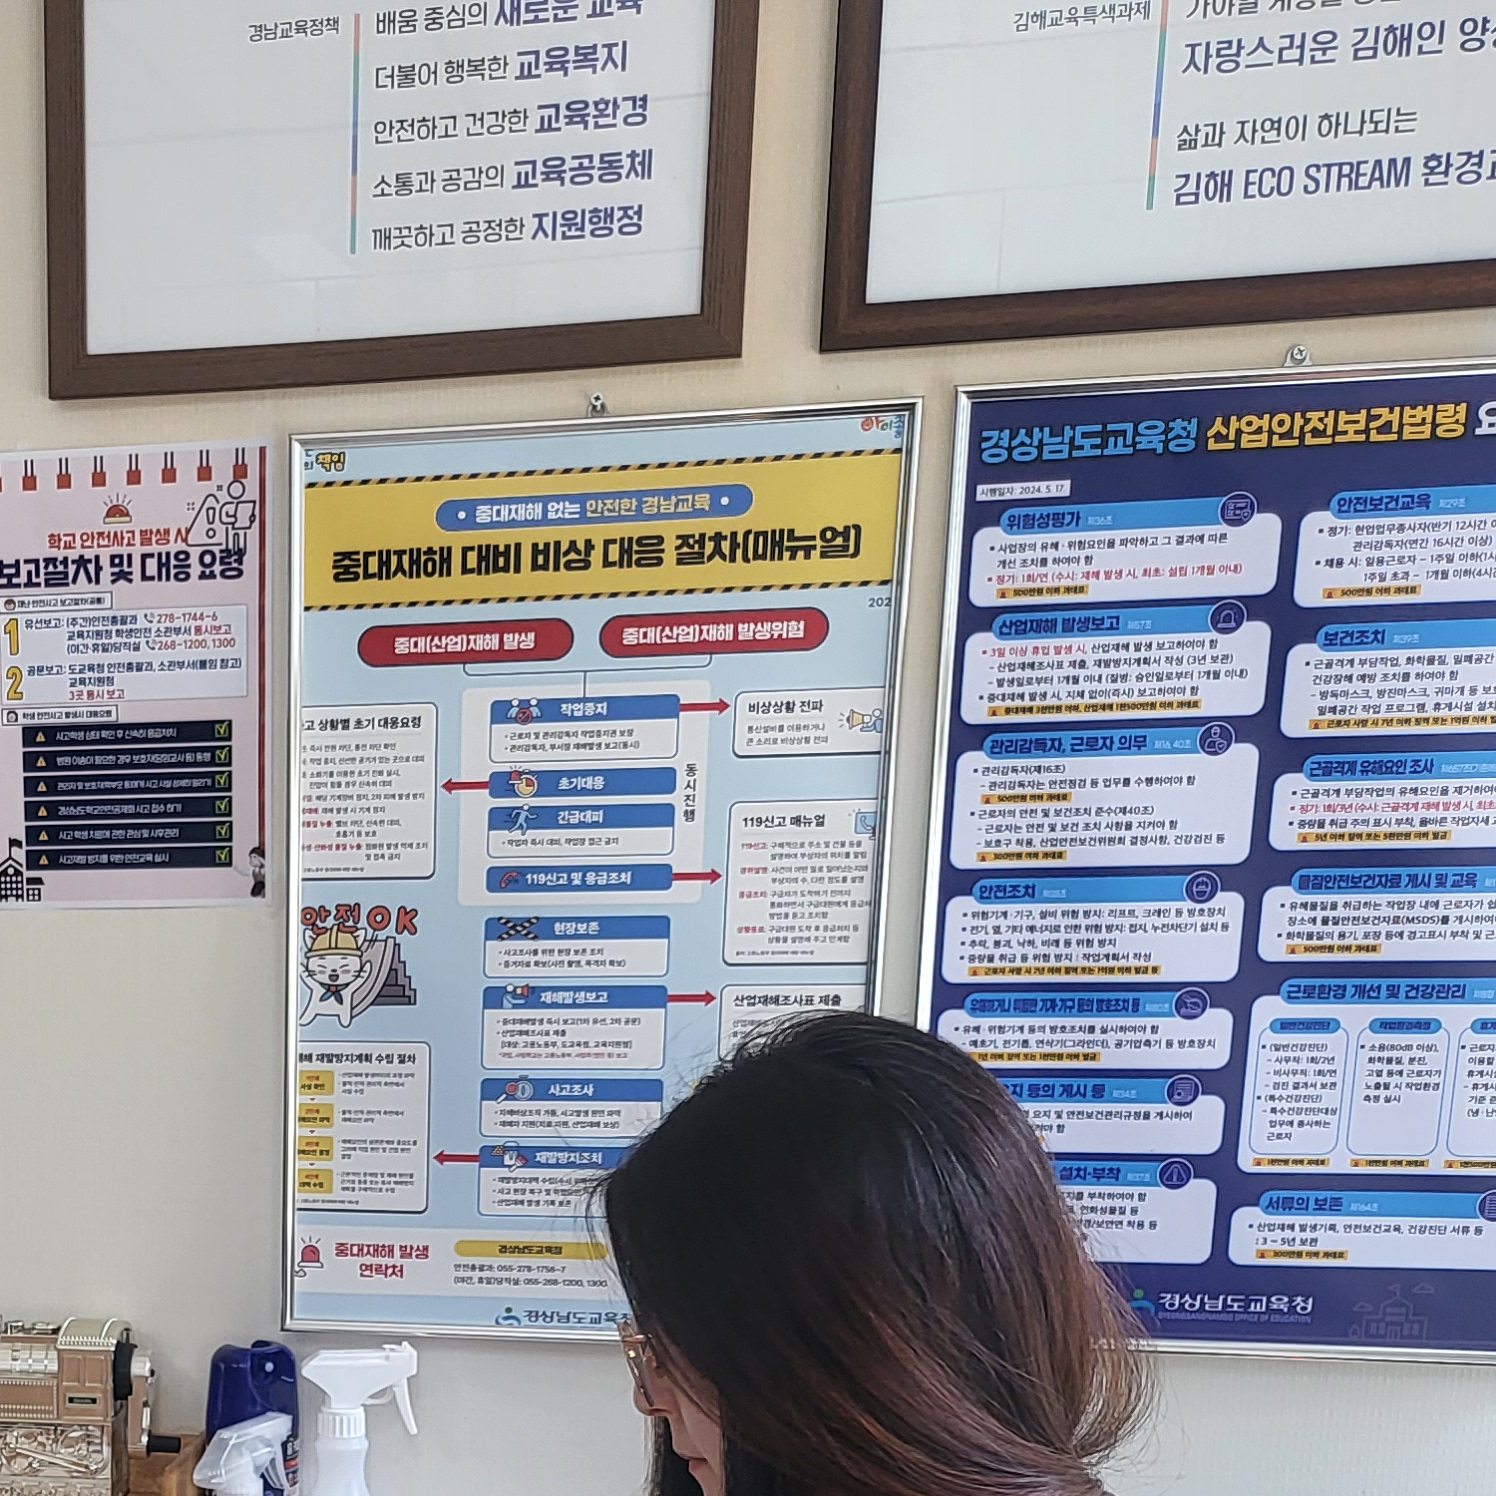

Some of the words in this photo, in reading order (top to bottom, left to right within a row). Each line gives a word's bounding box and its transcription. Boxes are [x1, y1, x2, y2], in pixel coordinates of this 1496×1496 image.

[377, 9, 418, 34] 배움
[424, 2, 487, 31] 중심의
[1014, 0, 1150, 32] 김해교육특색과제
[249, 17, 339, 42] 경남교육정책
[1182, 31, 1338, 74] 자랑스러운
[1352, 20, 1445, 61] 김해인
[376, 62, 437, 89] 더불어
[445, 55, 509, 84] 행복한
[515, 41, 627, 80] 교육복지
[374, 116, 458, 144] 안전하고
[465, 108, 529, 136] 건강한
[535, 94, 647, 133] 교육환경
[1177, 122, 1226, 151] 삶과
[1234, 115, 1307, 145] 자연이
[1318, 107, 1417, 139] 하나되는
[373, 171, 436, 197] 소통과
[441, 165, 504, 192] 공감의
[512, 149, 652, 189] 교육공동체
[1174, 170, 1233, 205] 김해
[1244, 166, 1294, 199] ECO
[1304, 157, 1411, 194] STREAM
[372, 224, 455, 250] 깨끗하고
[461, 217, 525, 244] 공정한
[532, 204, 642, 241] 지원행정
[978, 417, 1198, 464] 경상남도교육청
[1206, 402, 1468, 452] 산업안전보건법령
[475, 502, 542, 524] 중대재해
[547, 502, 580, 522] 없는
[586, 496, 638, 519] 안전한
[642, 493, 710, 515] 경남교육
[1337, 494, 1431, 514] 안전보건교육
[1006, 510, 1081, 531] 위험성평가
[48, 533, 76, 551] 학교
[80, 530, 135, 549] 안전사고
[140, 528, 172, 548] 발생
[332, 546, 452, 584] 중대재해
[461, 544, 521, 576] 대비
[530, 539, 595, 573] 비상
[604, 535, 665, 570] 대응
[674, 524, 862, 565] 절차(매뉴얼)
[110, 554, 133, 584] 및
[141, 551, 191, 582] 대응
[198, 547, 246, 580] 요령
[622, 622, 734, 646] 중대(산업)재해
[738, 620, 805, 641] 발생위험
[999, 618, 1058, 635] 산업재해
[1062, 616, 1120, 631] 발생보고
[393, 631, 499, 655] 중대(산업)재해
[504, 629, 535, 652] 발생
[1323, 629, 1386, 646] 보건조치
[560, 702, 607, 717] 작업중지
[749, 700, 796, 714] 비상상황
[800, 700, 823, 712] 전파
[1070, 736, 1113, 752] 근로자
[1117, 735, 1147, 750] 의무
[558, 776, 605, 790] 초기대응
[557, 810, 604, 824] 긴급대피
[743, 816, 786, 828] 119신고
[790, 814, 825, 827] 매뉴얼
[526, 873, 568, 885] 119신고
[571, 872, 582, 885] 및
[585, 871, 632, 885] 응급조치
[979, 884, 1035, 899] 안전조치
[366, 906, 418, 935] OK
[733, 996, 814, 1008] 산업재해조사표
[818, 995, 841, 1006] 제출
[1286, 984, 1347, 999] 근로환경
[1351, 984, 1381, 999] 개선
[1386, 984, 1400, 999] 및
[1405, 984, 1466, 999] 건강관리
[1265, 1196, 1309, 1212] 서류의
[335, 1243, 394, 1260] 중대재해
[399, 1245, 429, 1259] 발생
[360, 1264, 403, 1278] 연락처
[1158, 1293, 1313, 1313] 경상남도교육청
